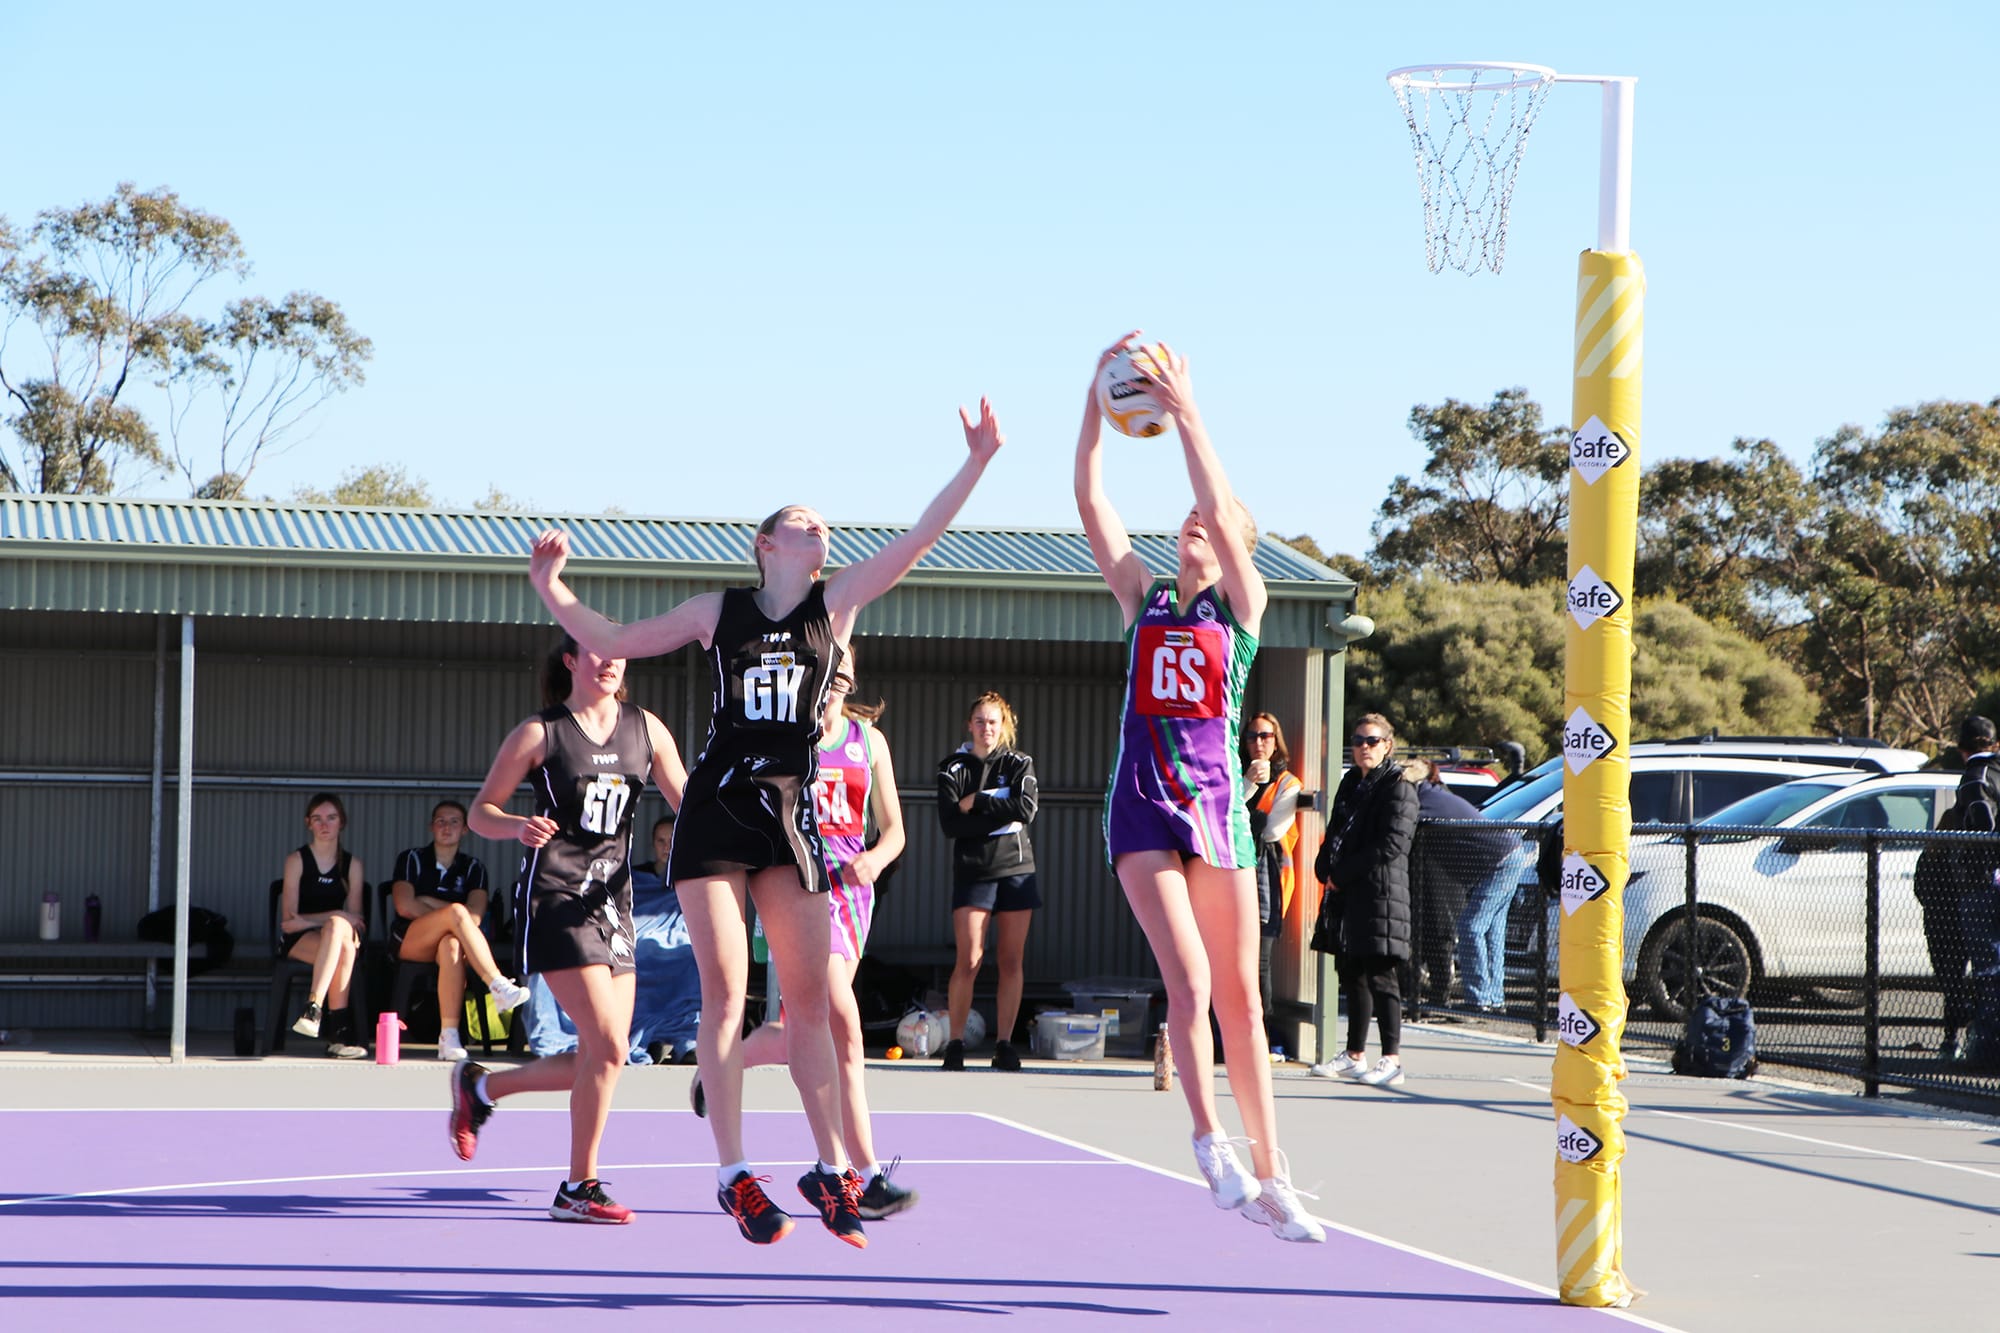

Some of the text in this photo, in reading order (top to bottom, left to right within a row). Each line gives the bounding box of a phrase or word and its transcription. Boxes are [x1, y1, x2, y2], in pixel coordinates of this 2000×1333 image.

[1573, 436, 1619, 458] Safe
[1569, 585, 1611, 608] Safe
[762, 632, 791, 642] TWP
[1151, 646, 1206, 702] GS
[743, 665, 805, 723] GK
[592, 753, 619, 765] TWP
[580, 781, 630, 835] GD
[810, 781, 853, 825] GA
[1560, 1012, 1588, 1035] afe
[1722, 1037, 1731, 1052] 3
[1558, 1132, 1590, 1153] afe
